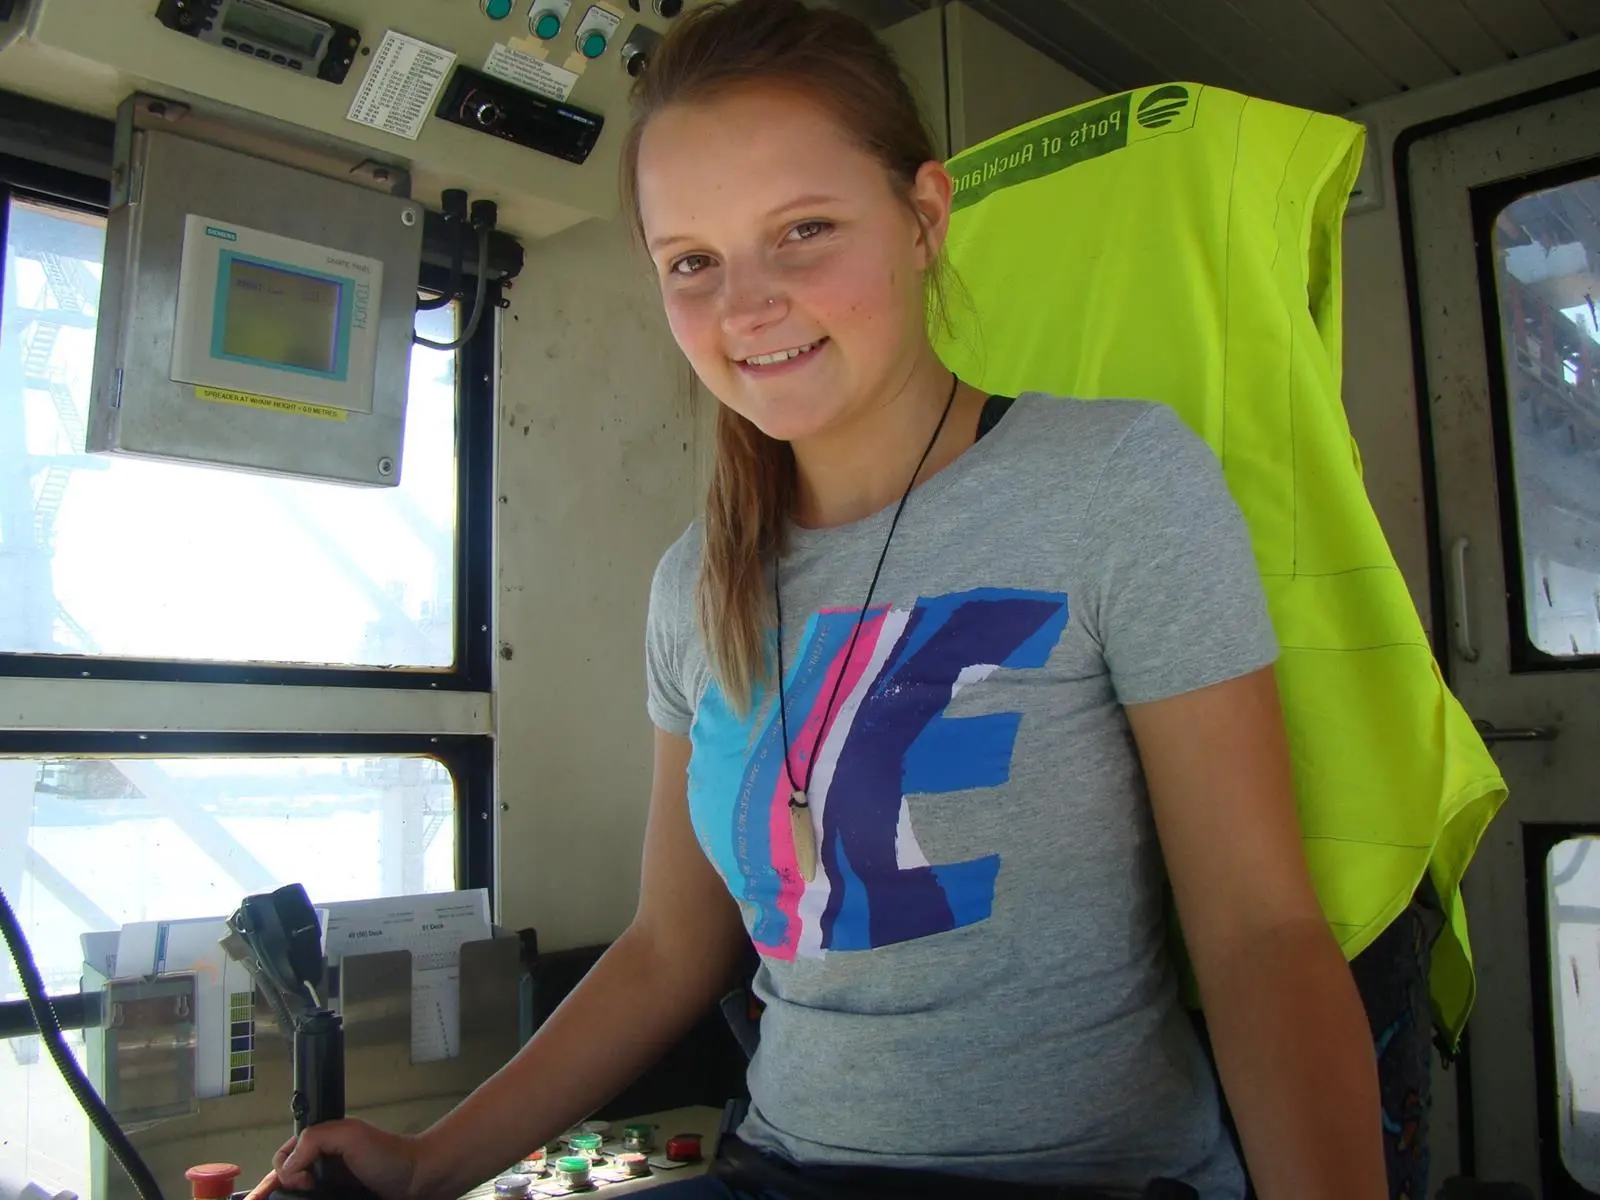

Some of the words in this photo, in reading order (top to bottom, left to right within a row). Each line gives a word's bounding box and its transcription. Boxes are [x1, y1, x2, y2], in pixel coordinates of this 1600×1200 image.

[206, 228, 236, 241] SIEMENS
[353, 283, 369, 330] TOUCH
[204, 390, 239, 401] SPREADER
[273, 401, 297, 411] HEIGHT
[313, 407, 337, 417] METRES
